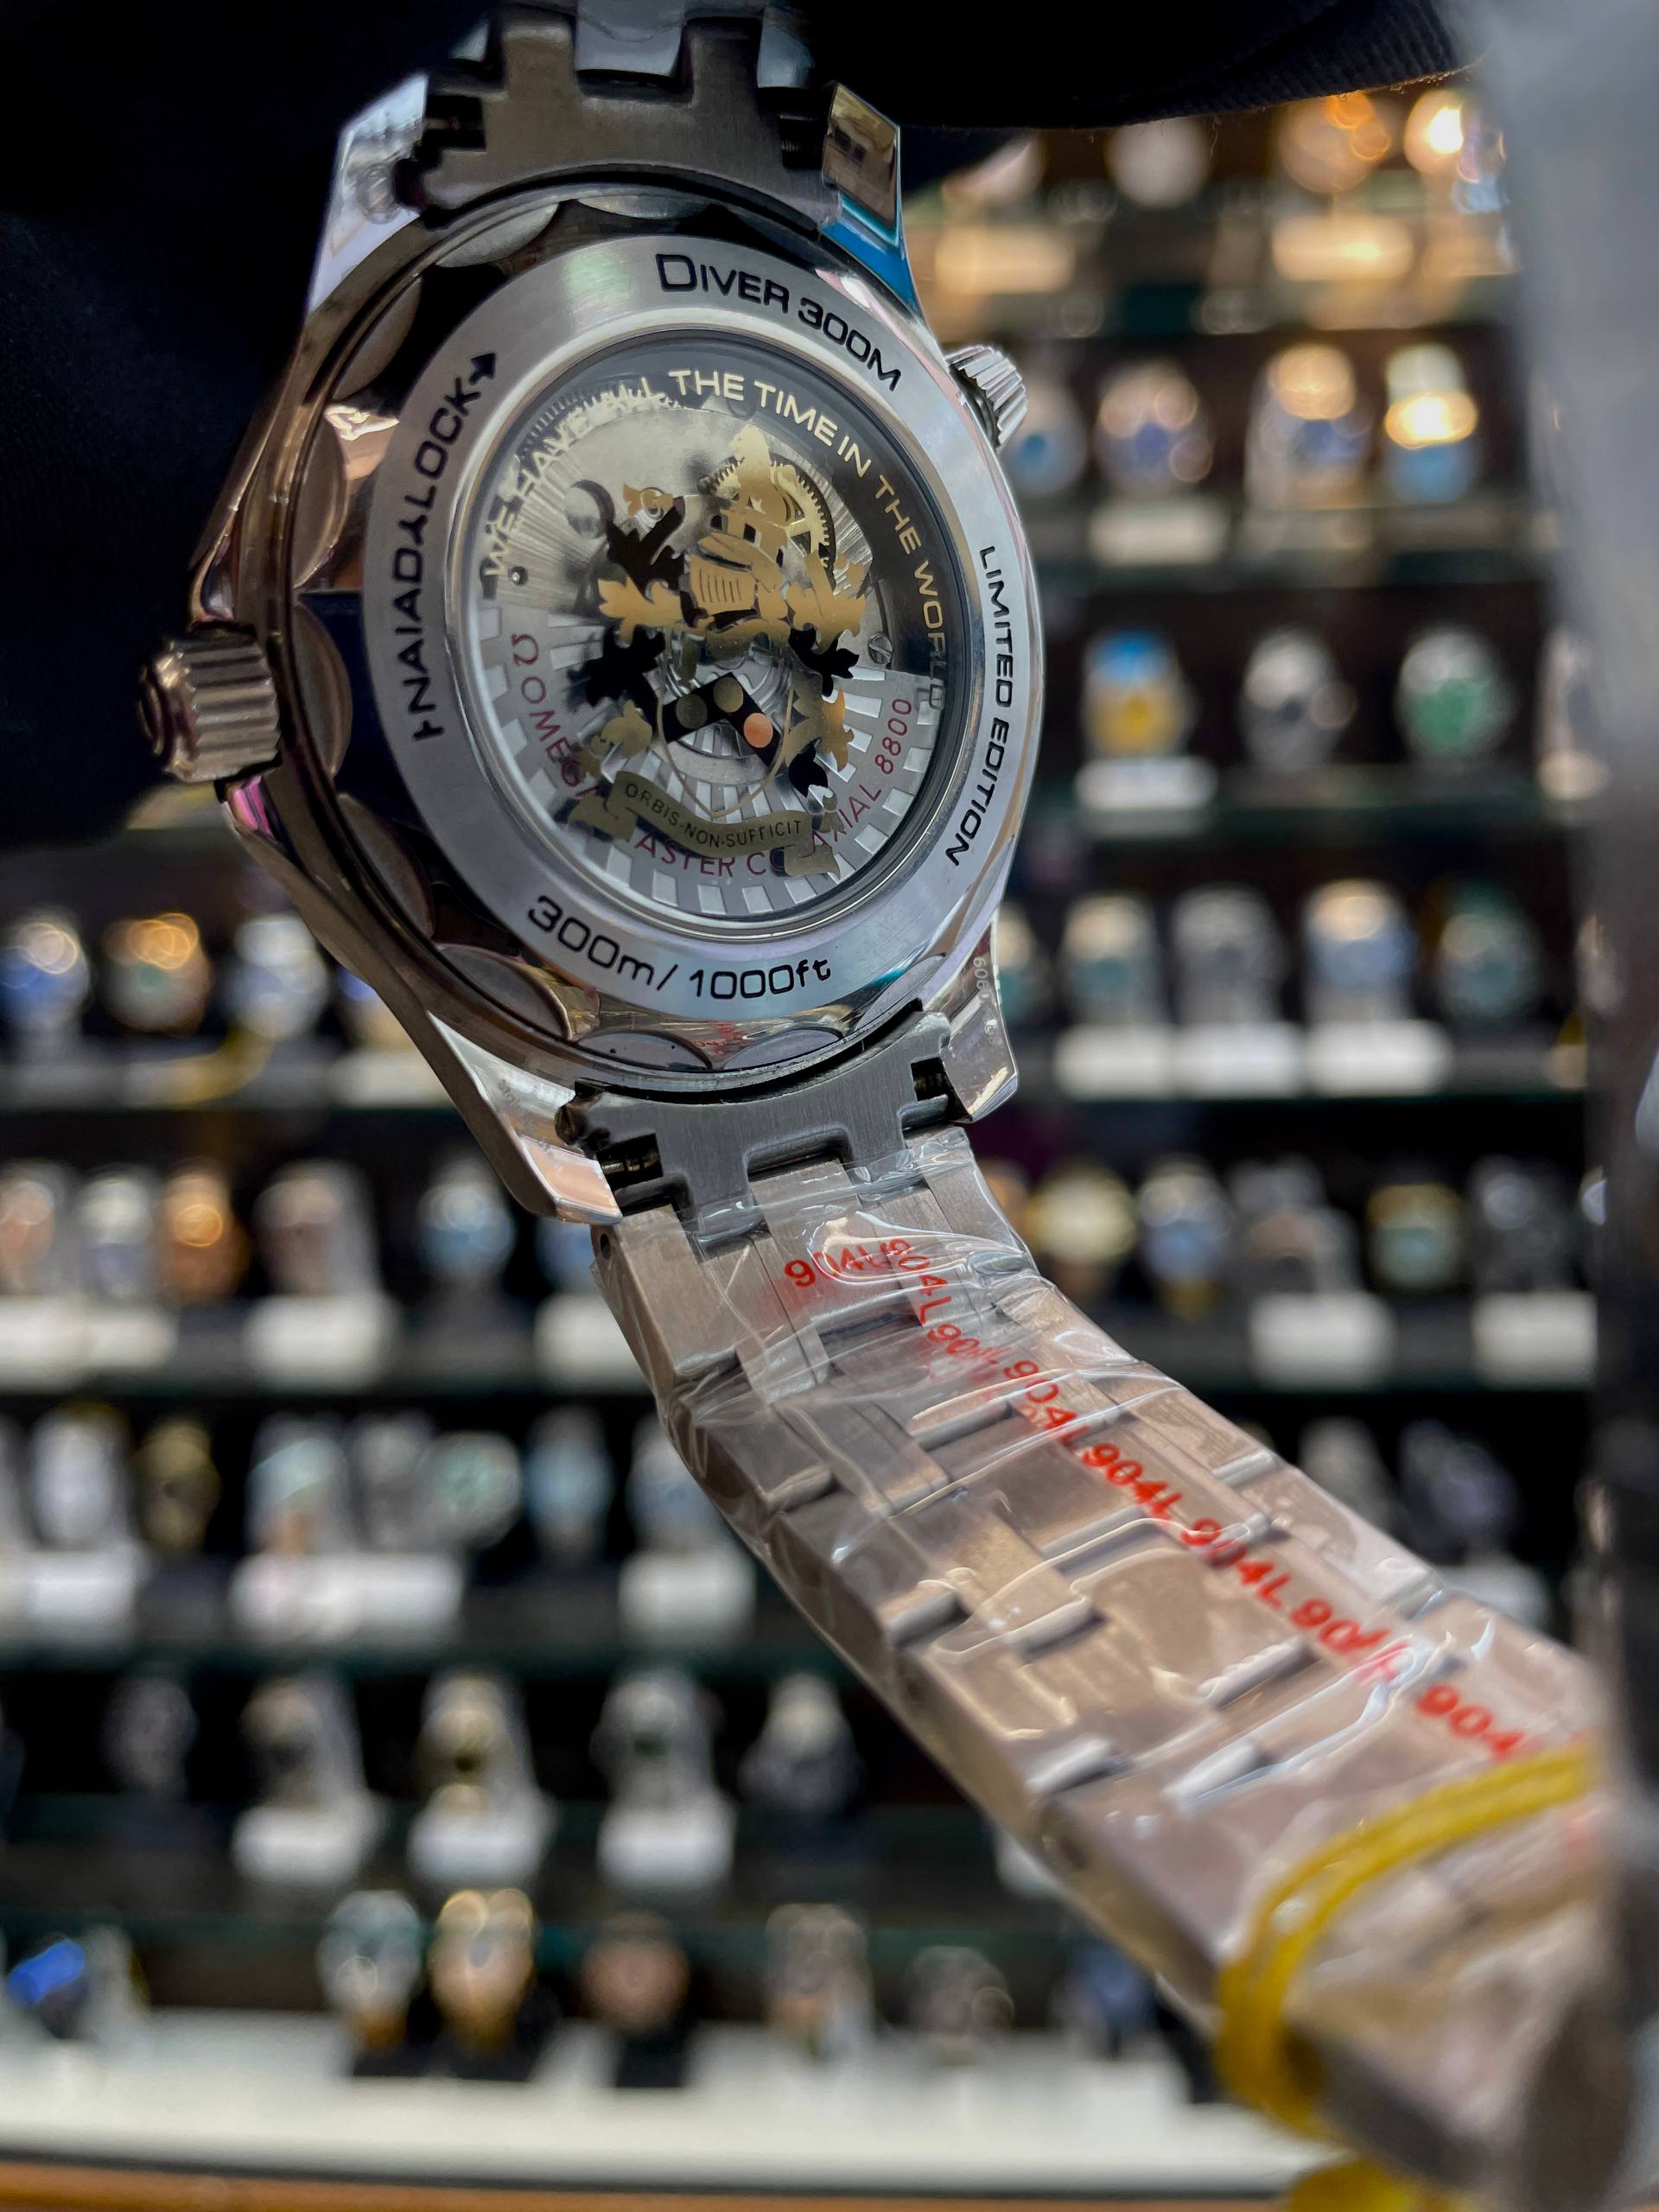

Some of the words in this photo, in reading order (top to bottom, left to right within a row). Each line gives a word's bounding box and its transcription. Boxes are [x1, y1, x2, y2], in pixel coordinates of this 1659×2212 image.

[656, 254, 789, 314] DIVER
[798, 296, 901, 391] 300M
[405, 376, 482, 510] LOCK
[669, 369, 744, 402] THE
[754, 381, 838, 447] TIME
[836, 433, 871, 478] IN
[874, 475, 922, 556] THE
[393, 547, 437, 715] NAIAD
[980, 545, 1014, 709] LIMITED
[874, 698, 912, 775] 8800
[945, 716, 1010, 866] EDITION
[1082, 1442, 1184, 1521] 904L
